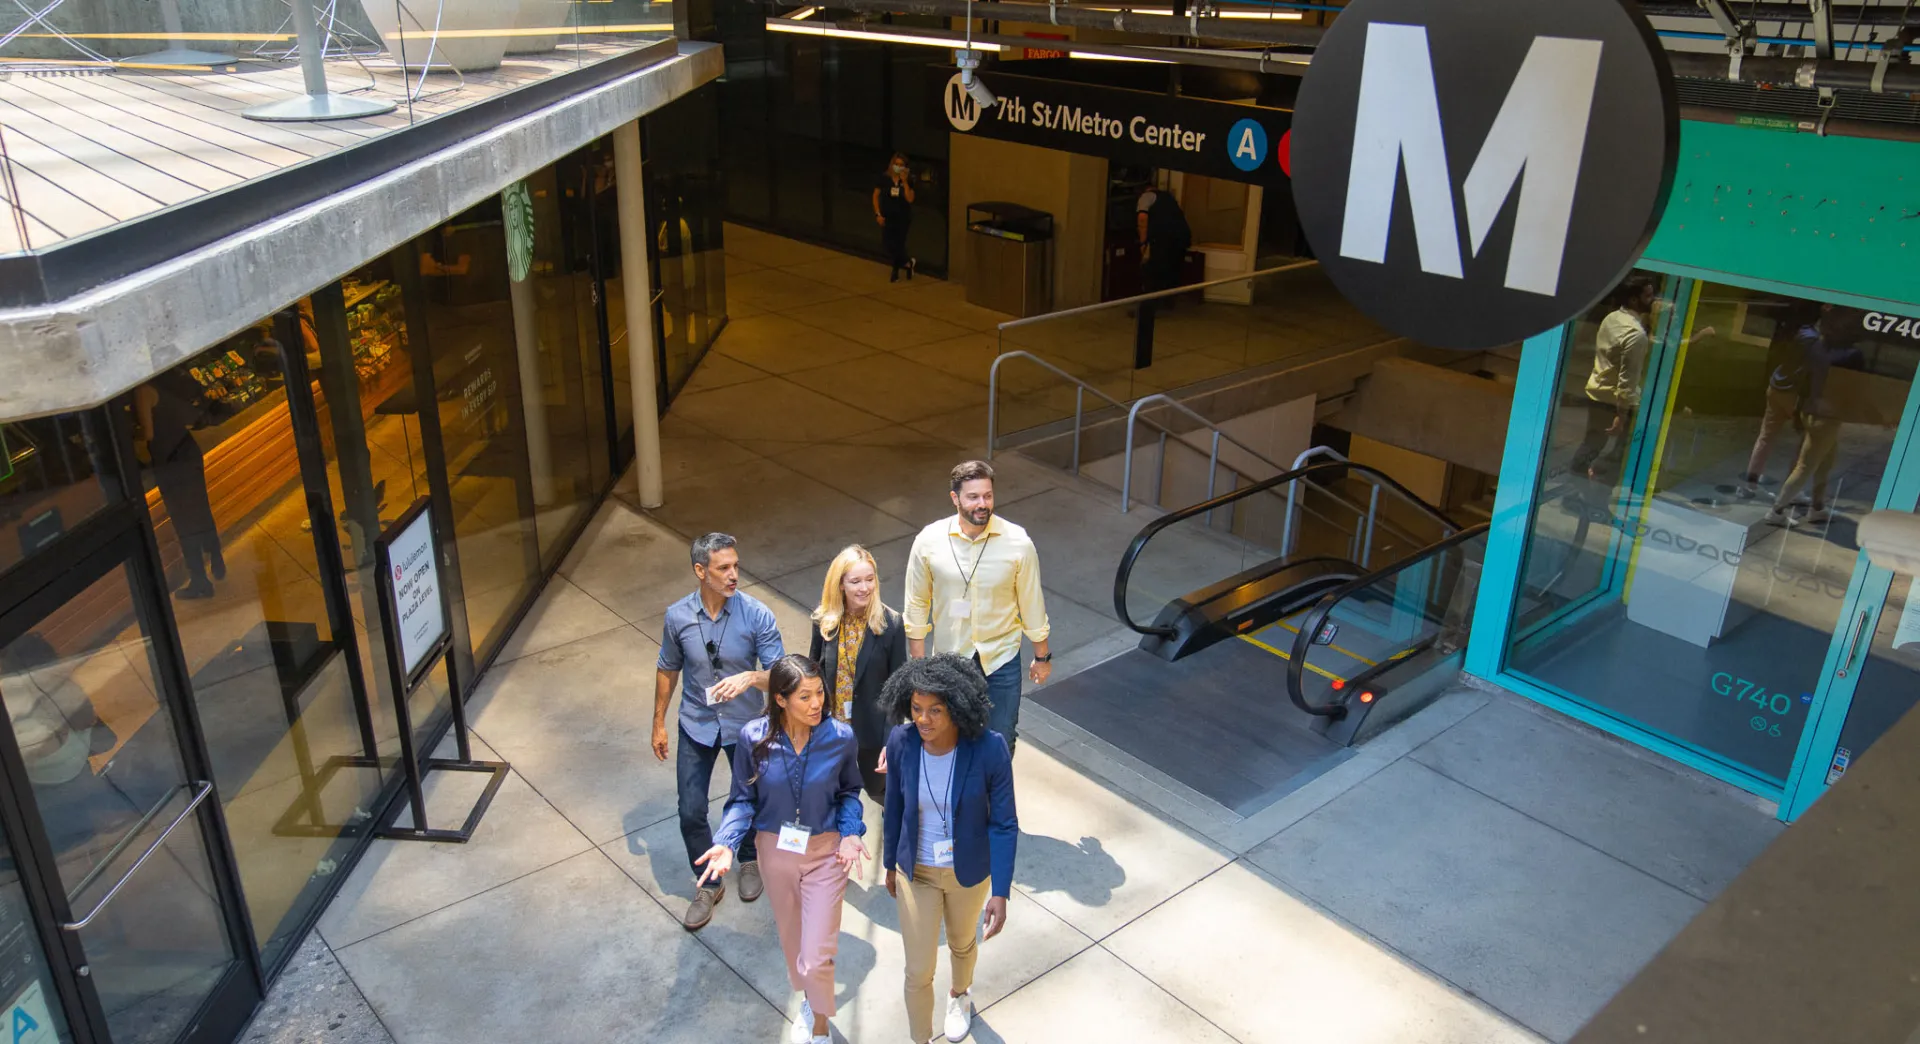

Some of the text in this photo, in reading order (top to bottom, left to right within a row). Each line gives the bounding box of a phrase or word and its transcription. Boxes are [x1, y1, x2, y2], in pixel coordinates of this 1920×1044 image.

[1028, 48, 1060, 58] FARGO
[997, 96, 1206, 152] 7th St/Metro Center
[1235, 127, 1257, 161] A
[1339, 22, 1604, 297] M
[398, 560, 430, 601] NOW OPEN
[412, 585, 421, 599] ON
[402, 601, 419, 625] PLAZA
[419, 584, 434, 605] LEVEL
[1711, 671, 1792, 715] G740
